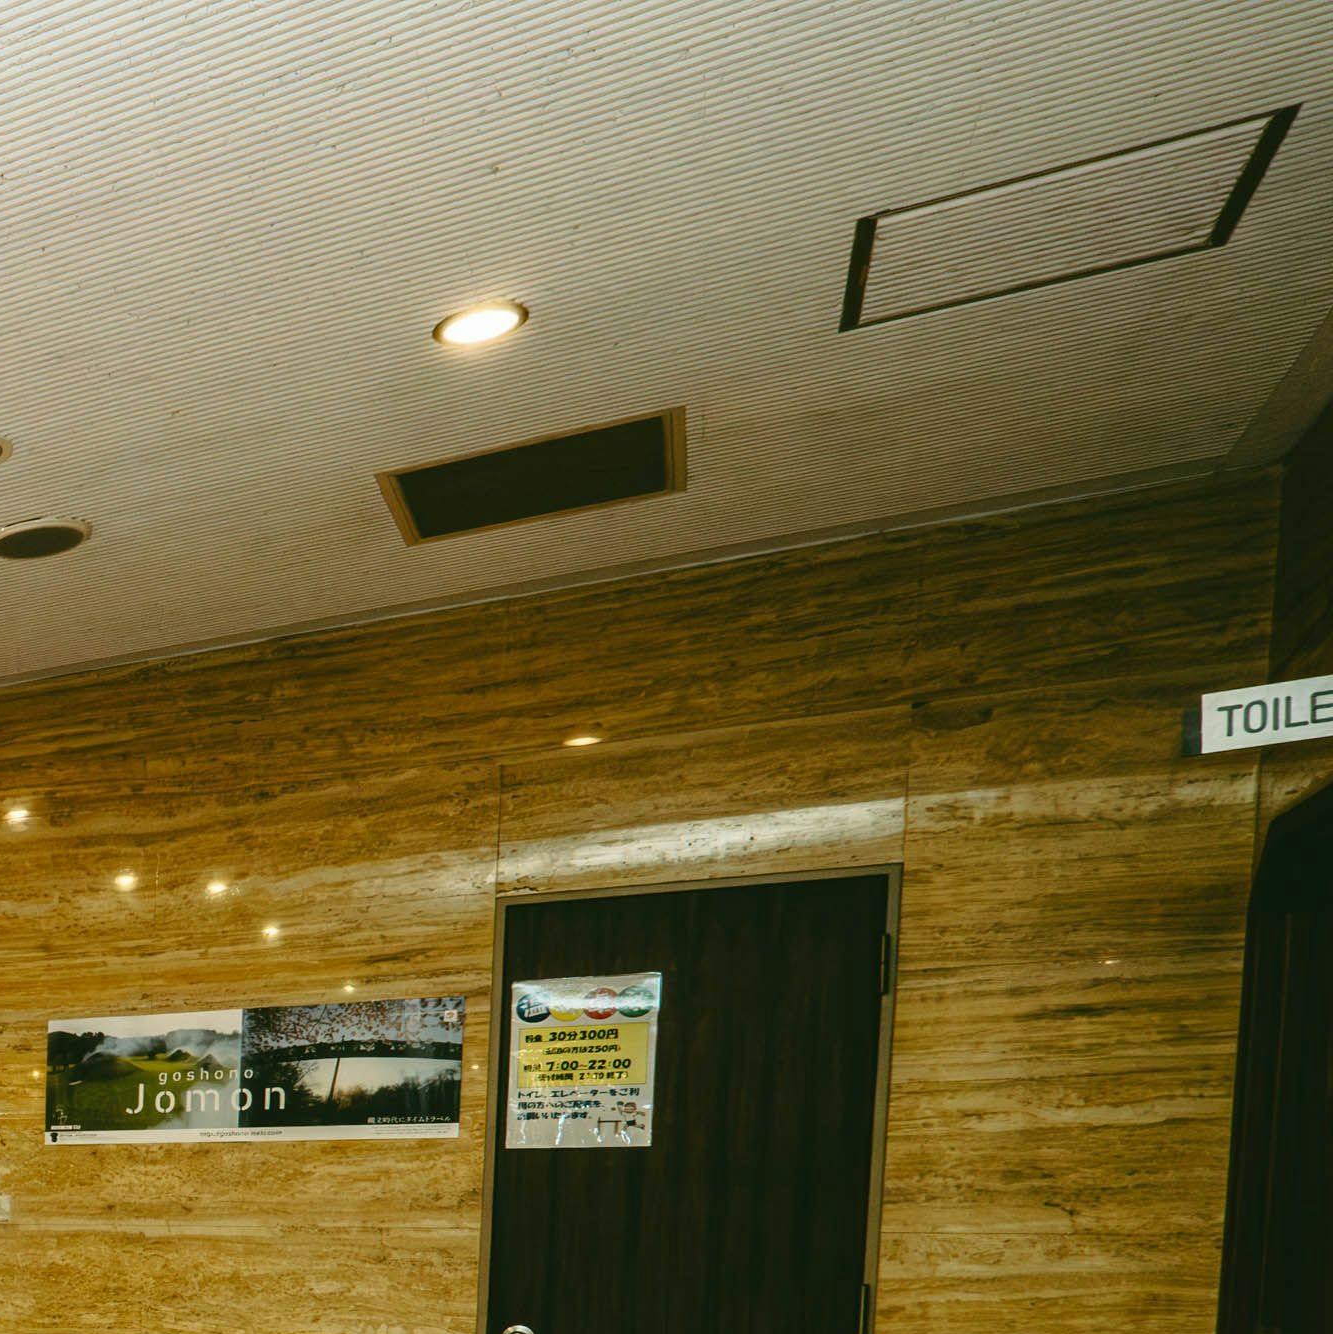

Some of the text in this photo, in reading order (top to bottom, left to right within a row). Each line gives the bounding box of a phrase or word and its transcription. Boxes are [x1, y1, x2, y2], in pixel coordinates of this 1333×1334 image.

[1217, 689, 1333, 737] TOILE
[549, 1028, 619, 1042] 30分300円
[158, 1068, 254, 1084] goshono
[125, 1083, 286, 1115] Jomon
